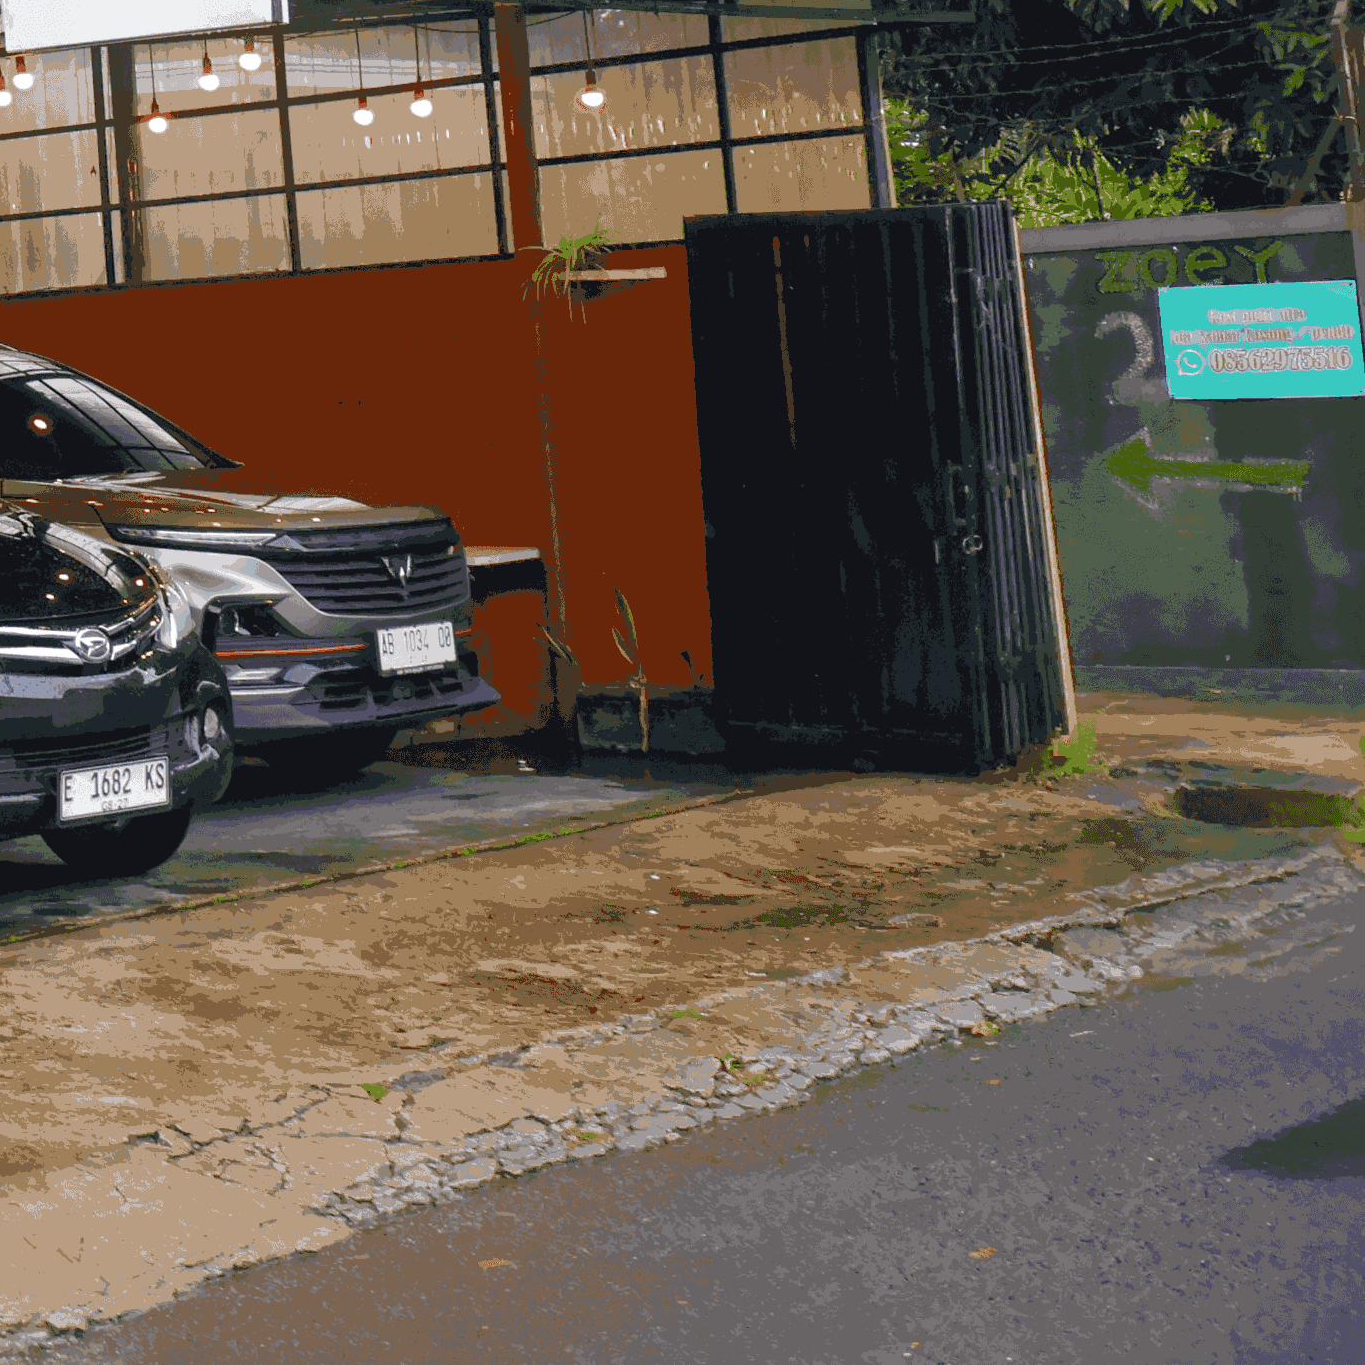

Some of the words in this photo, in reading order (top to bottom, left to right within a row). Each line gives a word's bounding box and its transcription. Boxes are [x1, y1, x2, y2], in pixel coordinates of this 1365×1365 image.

[1208, 346, 1353, 372] 08562975516
[382, 632, 394, 655] AB
[64, 775, 73, 802] E
[90, 767, 131, 798] 1682
[144, 762, 165, 790] KS
